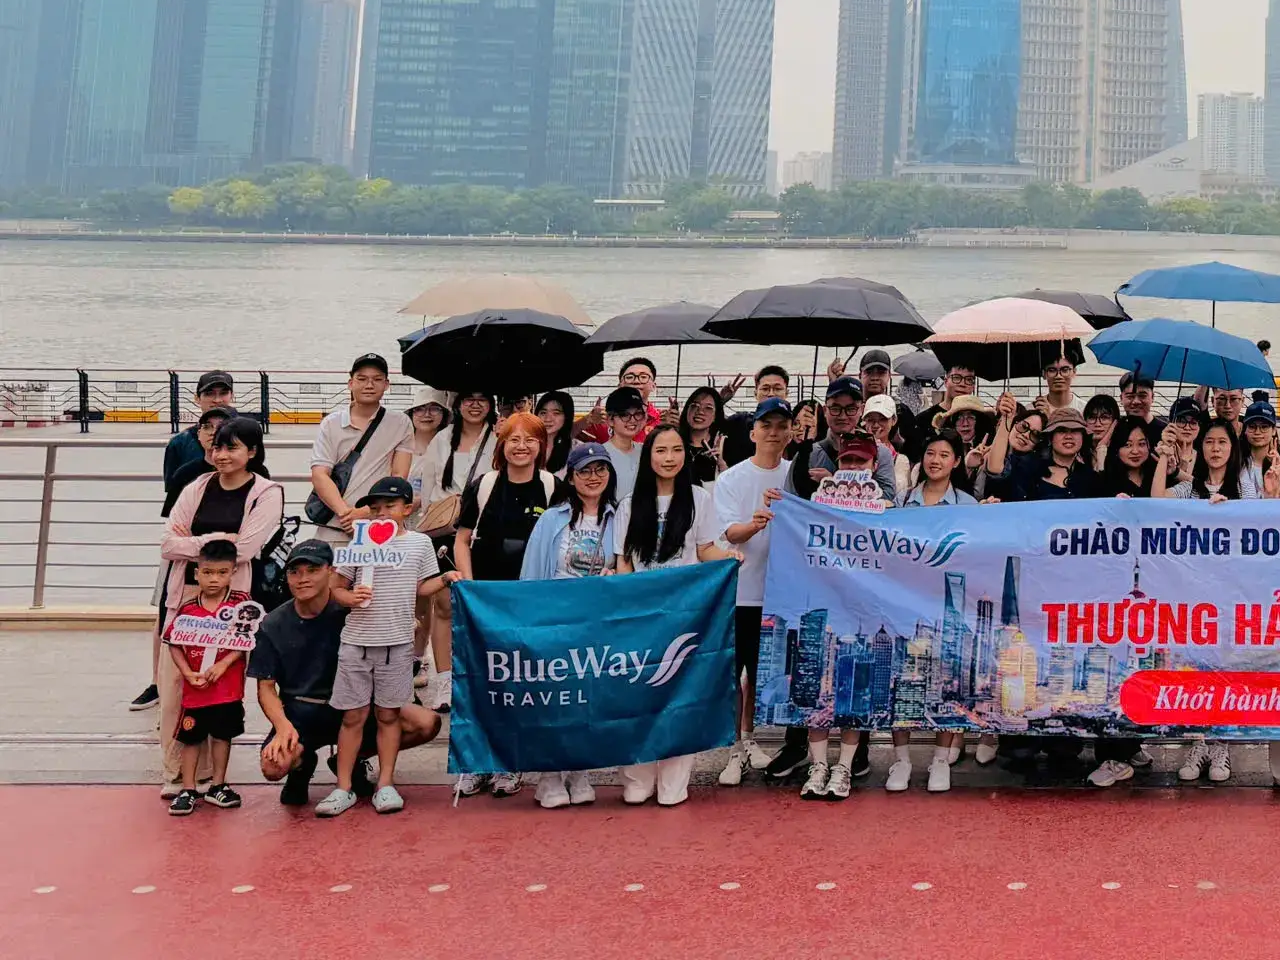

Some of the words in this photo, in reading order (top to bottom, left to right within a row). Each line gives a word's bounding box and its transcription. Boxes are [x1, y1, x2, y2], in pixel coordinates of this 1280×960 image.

[353, 522, 367, 545] I
[807, 523, 930, 562] BlueWay
[1050, 521, 1130, 556] CHÀO
[1140, 521, 1231, 556] MỪNG
[335, 548, 407, 566] BlueWay
[807, 553, 883, 569] TRAVEL
[1041, 597, 1219, 654] THƯỢNG
[486, 644, 652, 685] BlueWay
[488, 689, 588, 707] TRAVEL
[1153, 684, 1214, 711] Khởi
